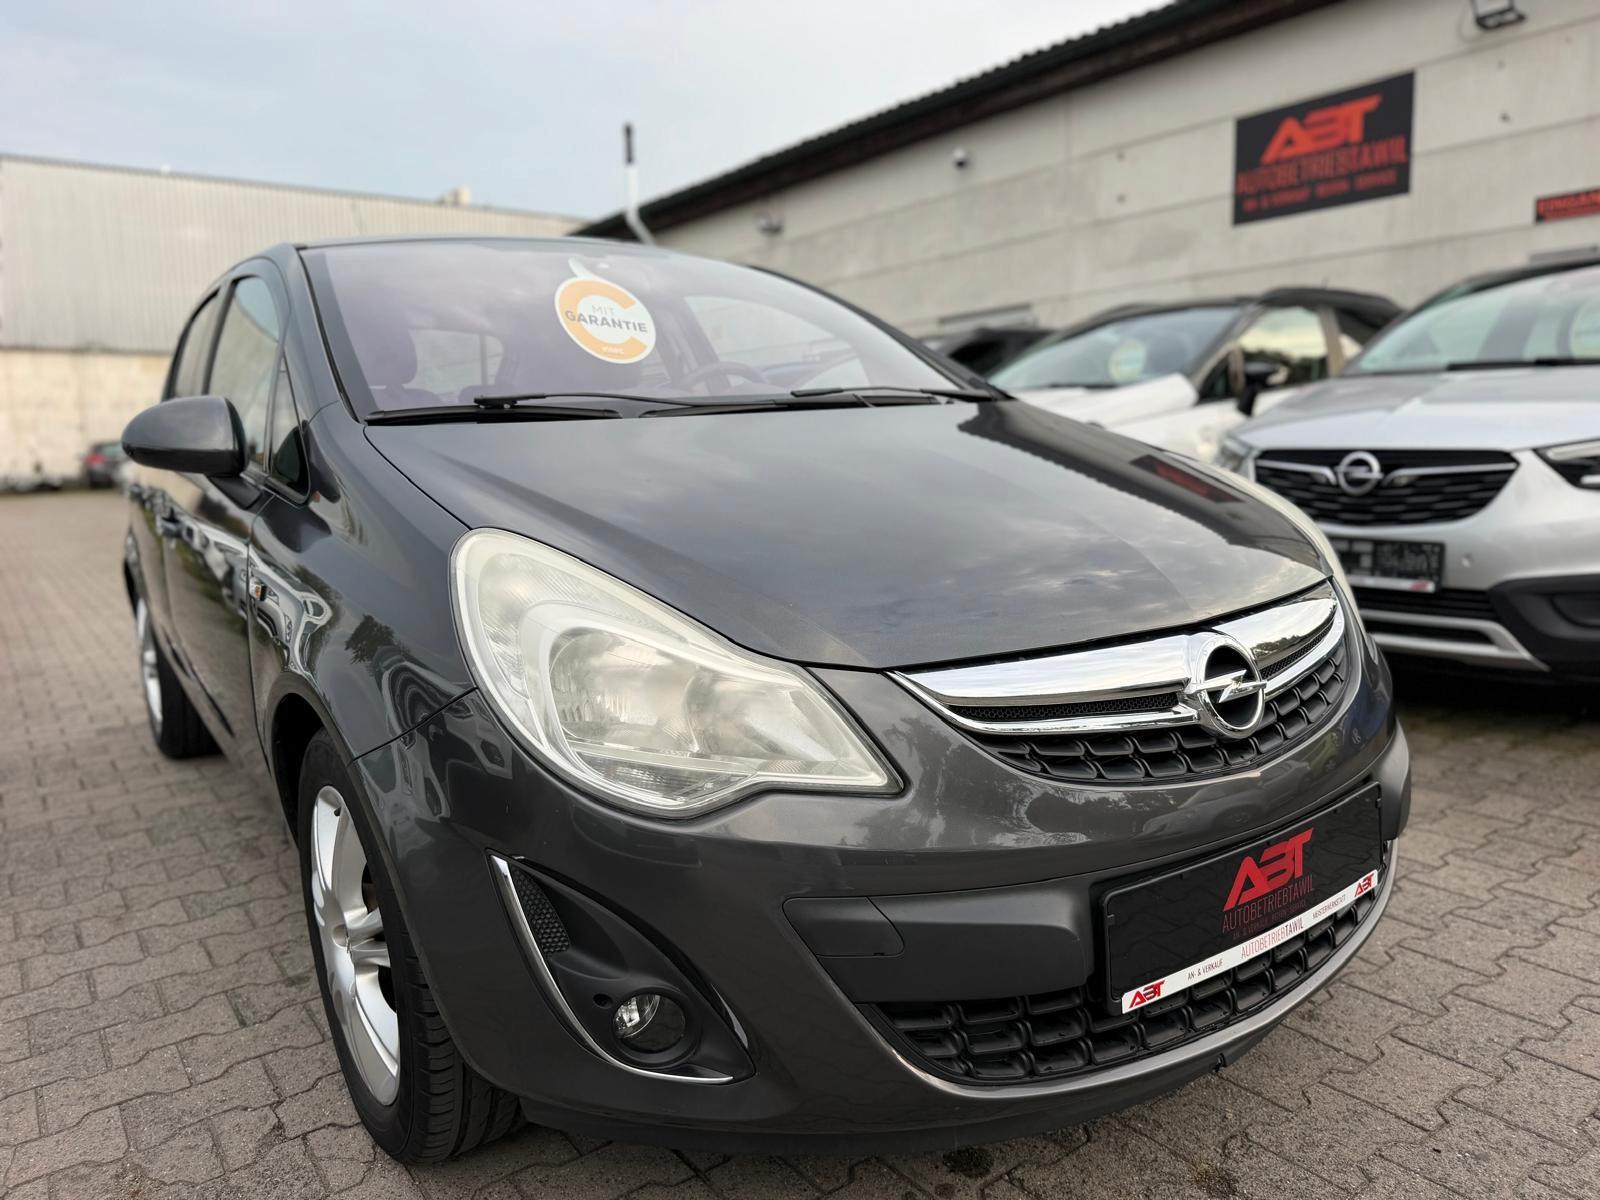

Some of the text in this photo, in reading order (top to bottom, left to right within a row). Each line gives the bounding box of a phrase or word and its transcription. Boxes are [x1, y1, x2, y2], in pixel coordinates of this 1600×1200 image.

[565, 310, 648, 333] GARANTIE
[591, 304, 615, 316] MIT
[1222, 827, 1314, 913] ABT
[1354, 873, 1375, 898] ABT
[1222, 874, 1315, 934] AUTOBETRIEBTAWIL
[1240, 917, 1304, 960] AUTOBETRIEBTAWIL
[1202, 958, 1224, 975] VERKAUF
[1128, 979, 1166, 1009] ABT
